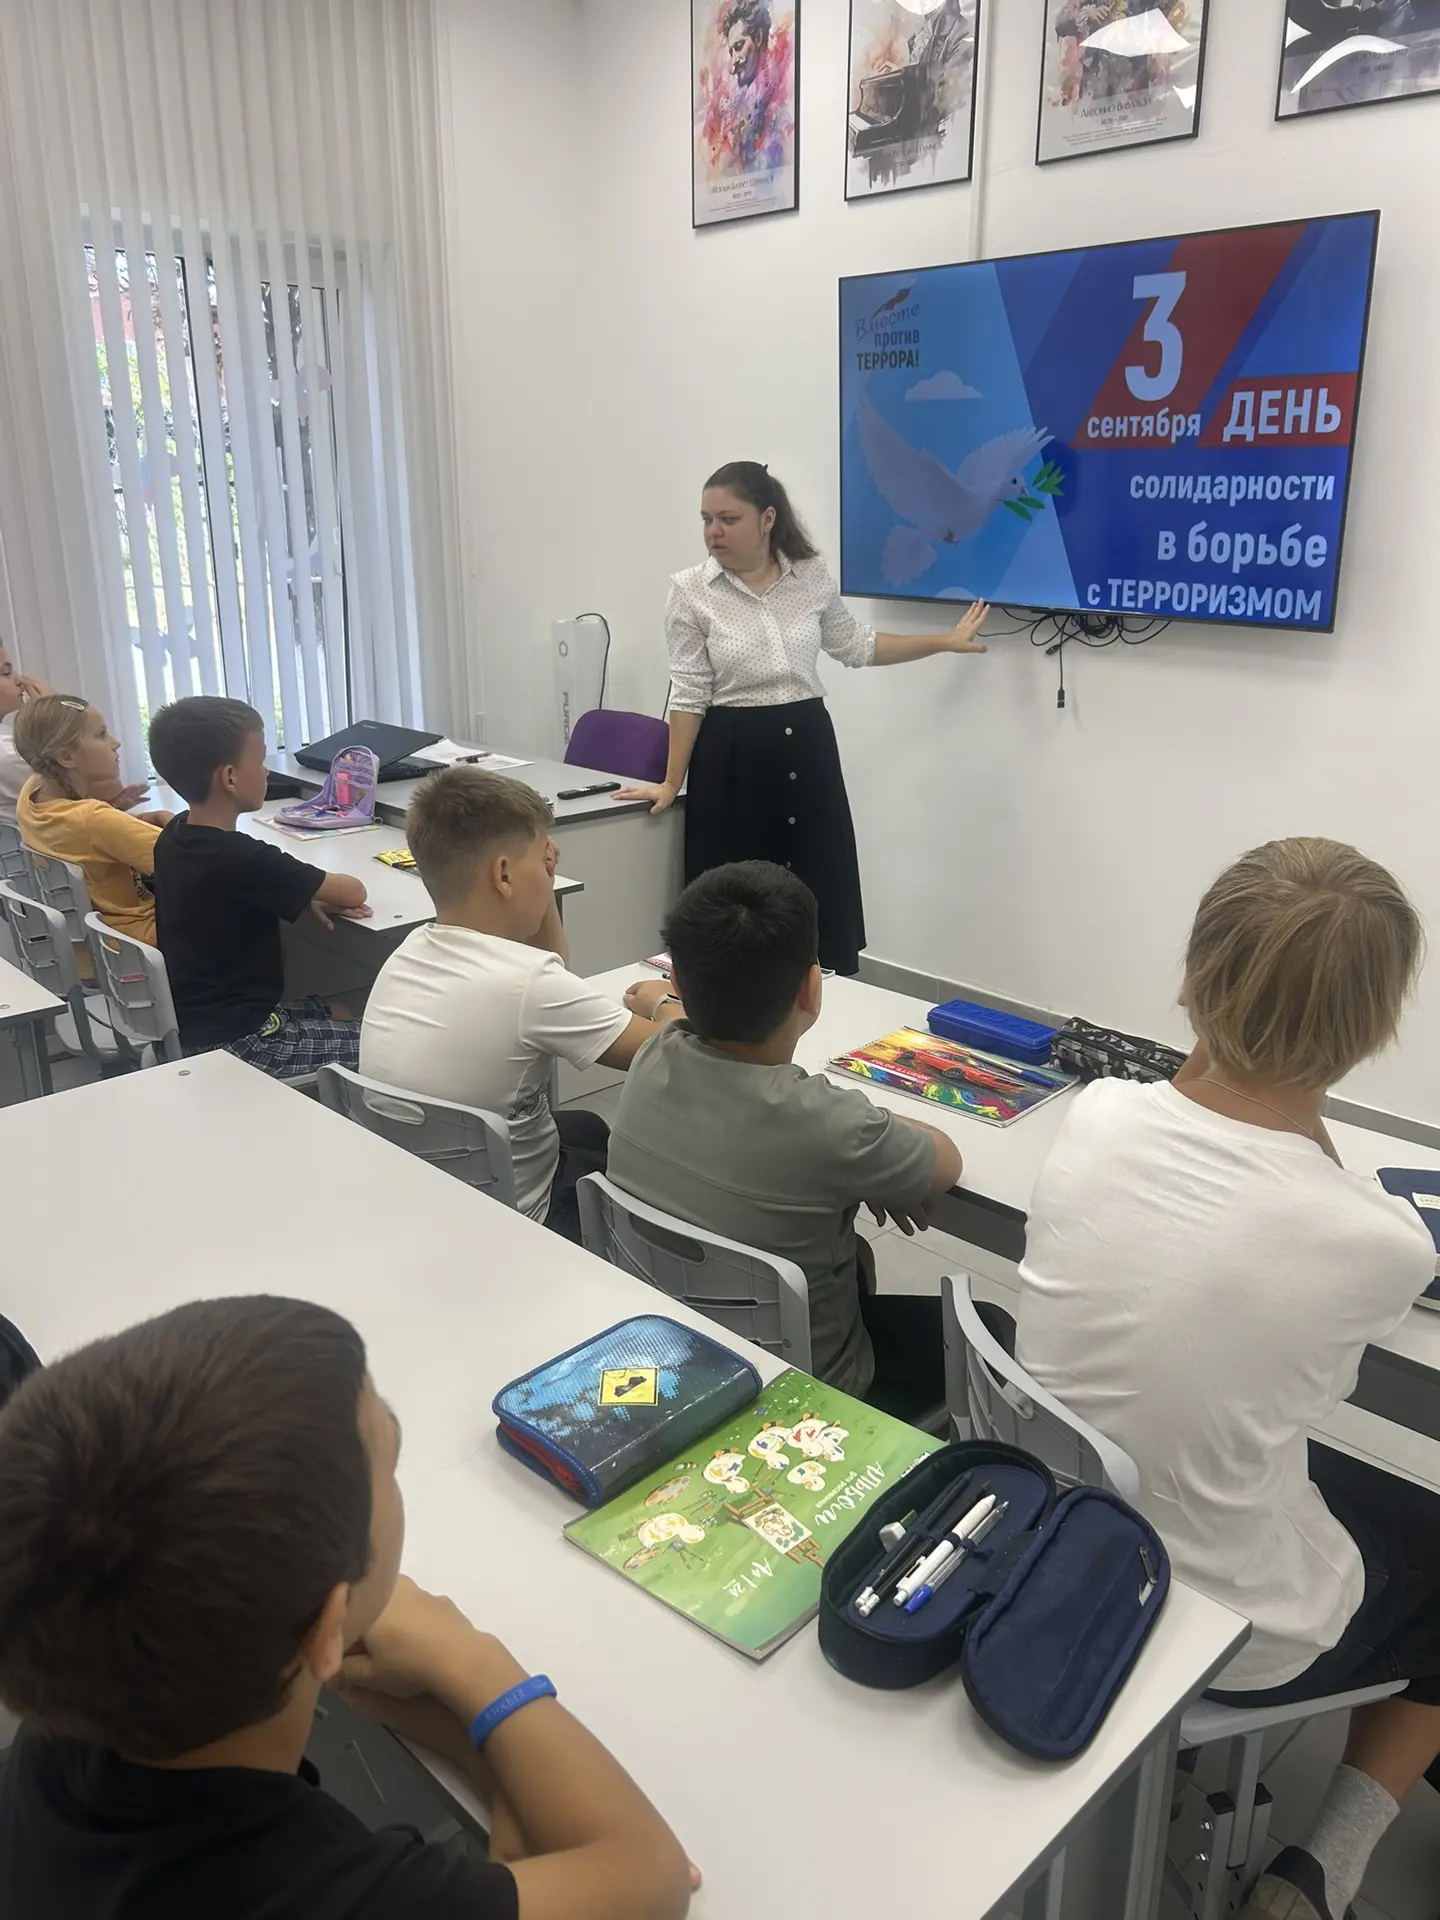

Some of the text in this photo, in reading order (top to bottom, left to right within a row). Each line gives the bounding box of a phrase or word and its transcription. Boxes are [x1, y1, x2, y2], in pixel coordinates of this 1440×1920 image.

[875, 329, 920, 351] против
[1125, 271, 1187, 402] 3
[856, 350, 919, 371] ТЕРРОРА!
[1087, 407, 1201, 443] сентября
[1222, 387, 1342, 442] ДЕНЬ
[1130, 475, 1335, 507] солидарности
[1157, 520, 1328, 574] в борьбе
[1087, 578, 1322, 621] с ТЕРРОРИЗМОМ
